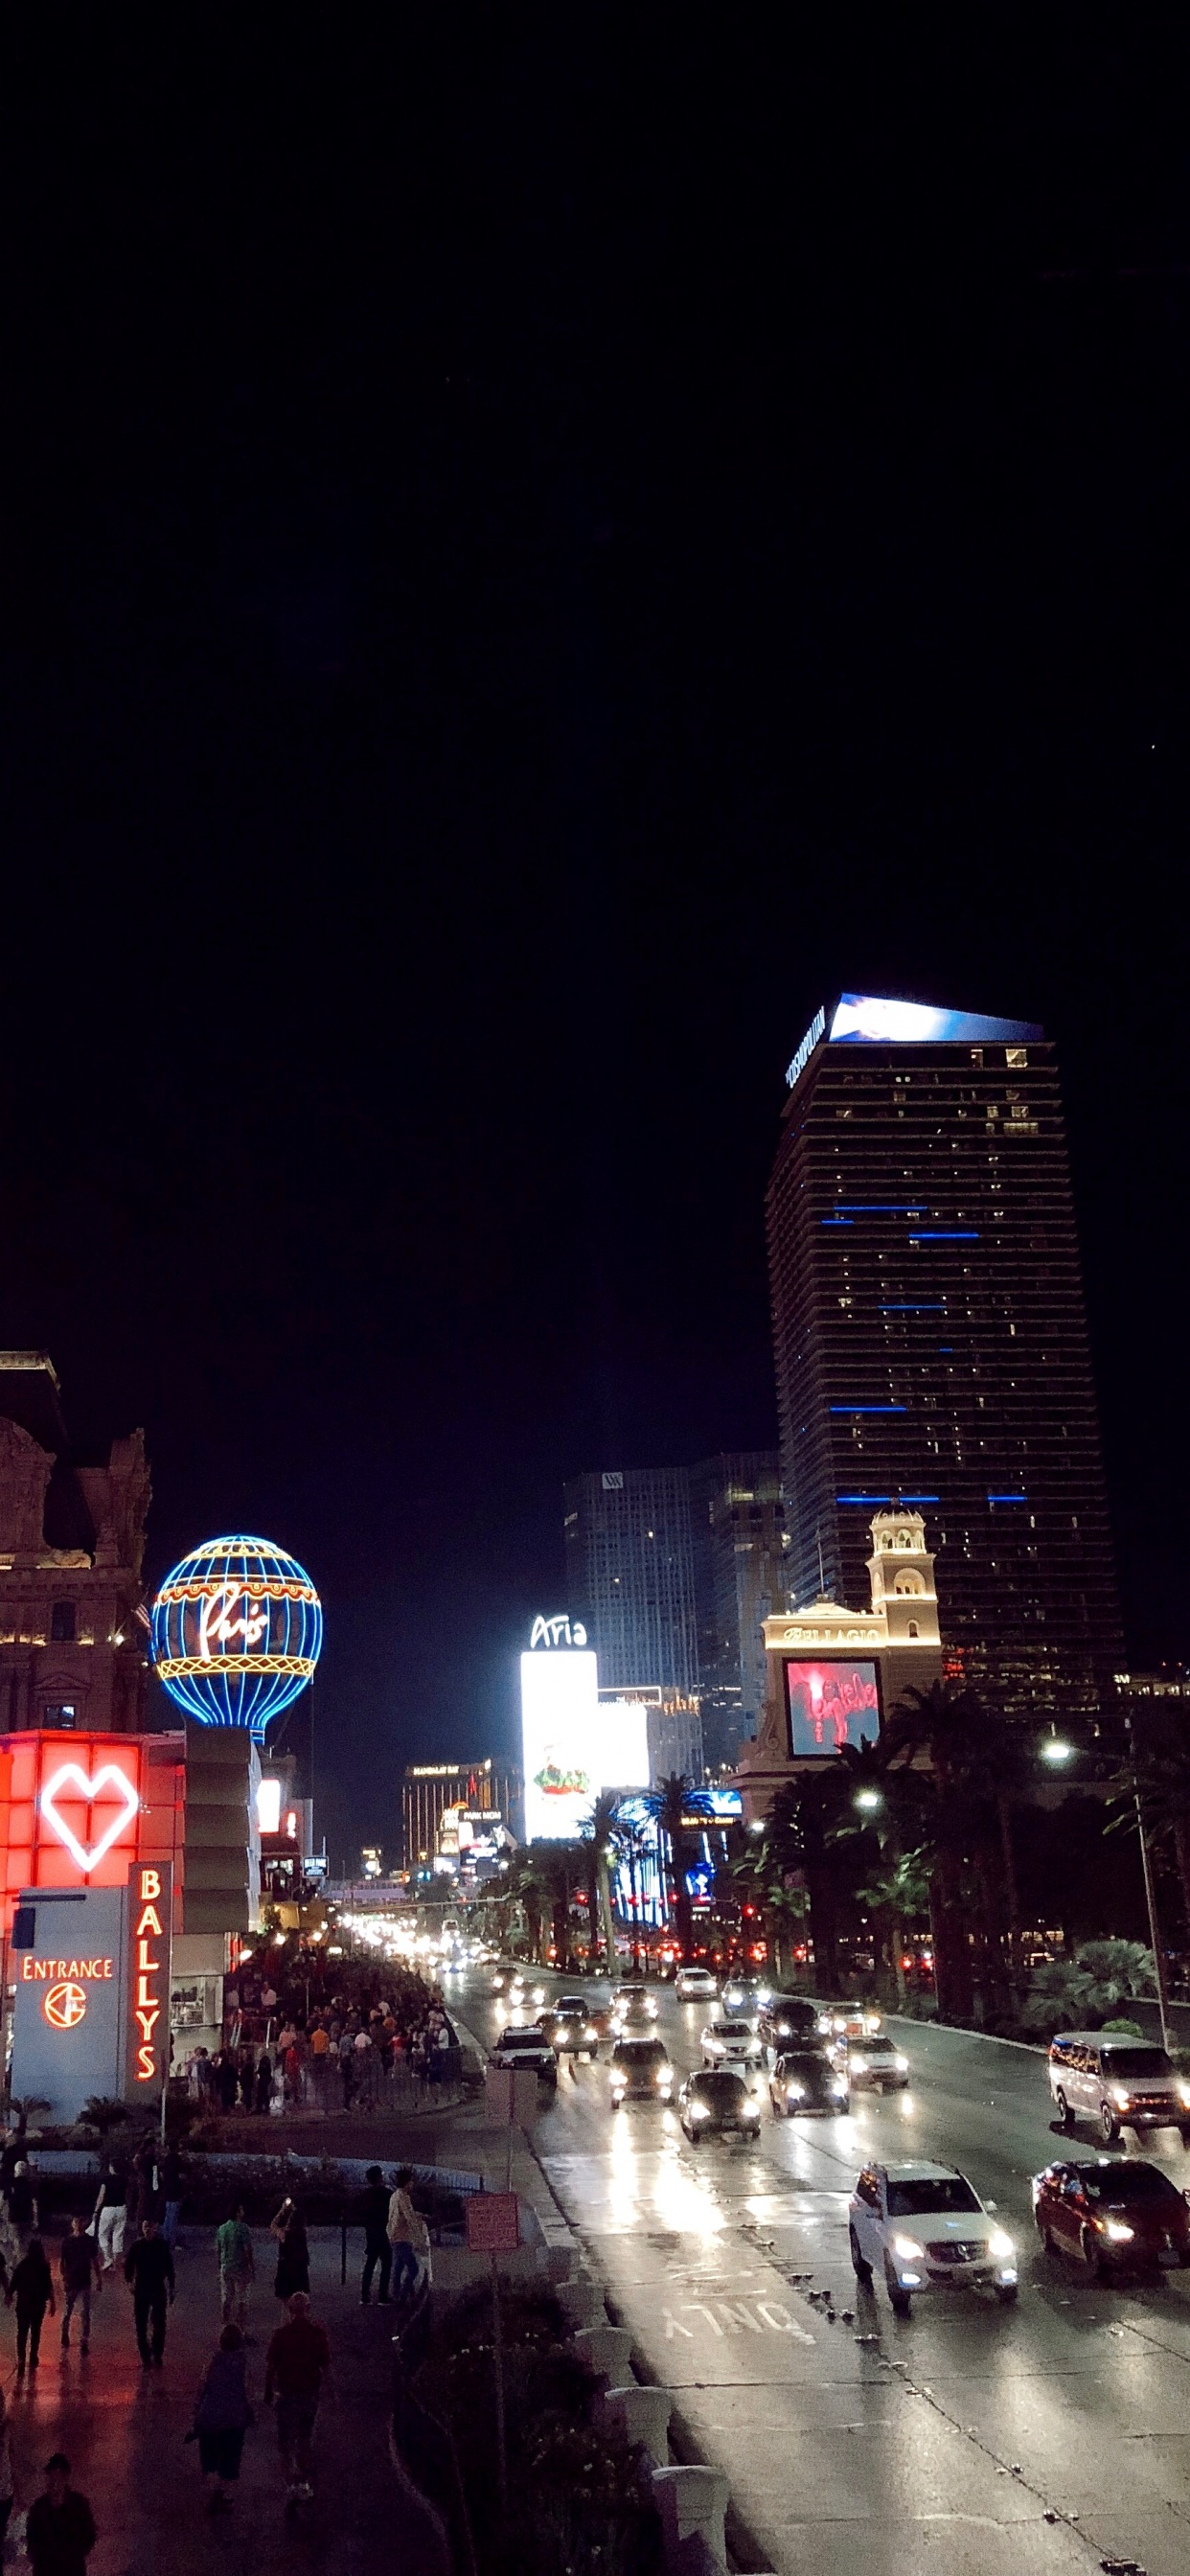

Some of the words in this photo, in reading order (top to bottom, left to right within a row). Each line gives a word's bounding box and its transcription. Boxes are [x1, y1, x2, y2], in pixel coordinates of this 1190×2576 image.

[198, 1581, 269, 1664] Paris
[531, 1615, 587, 1648] Aria
[22, 1956, 113, 1981] ENTRANCE
[136, 1870, 163, 2079] BALLYS
[661, 2302, 815, 2345] ONLY
